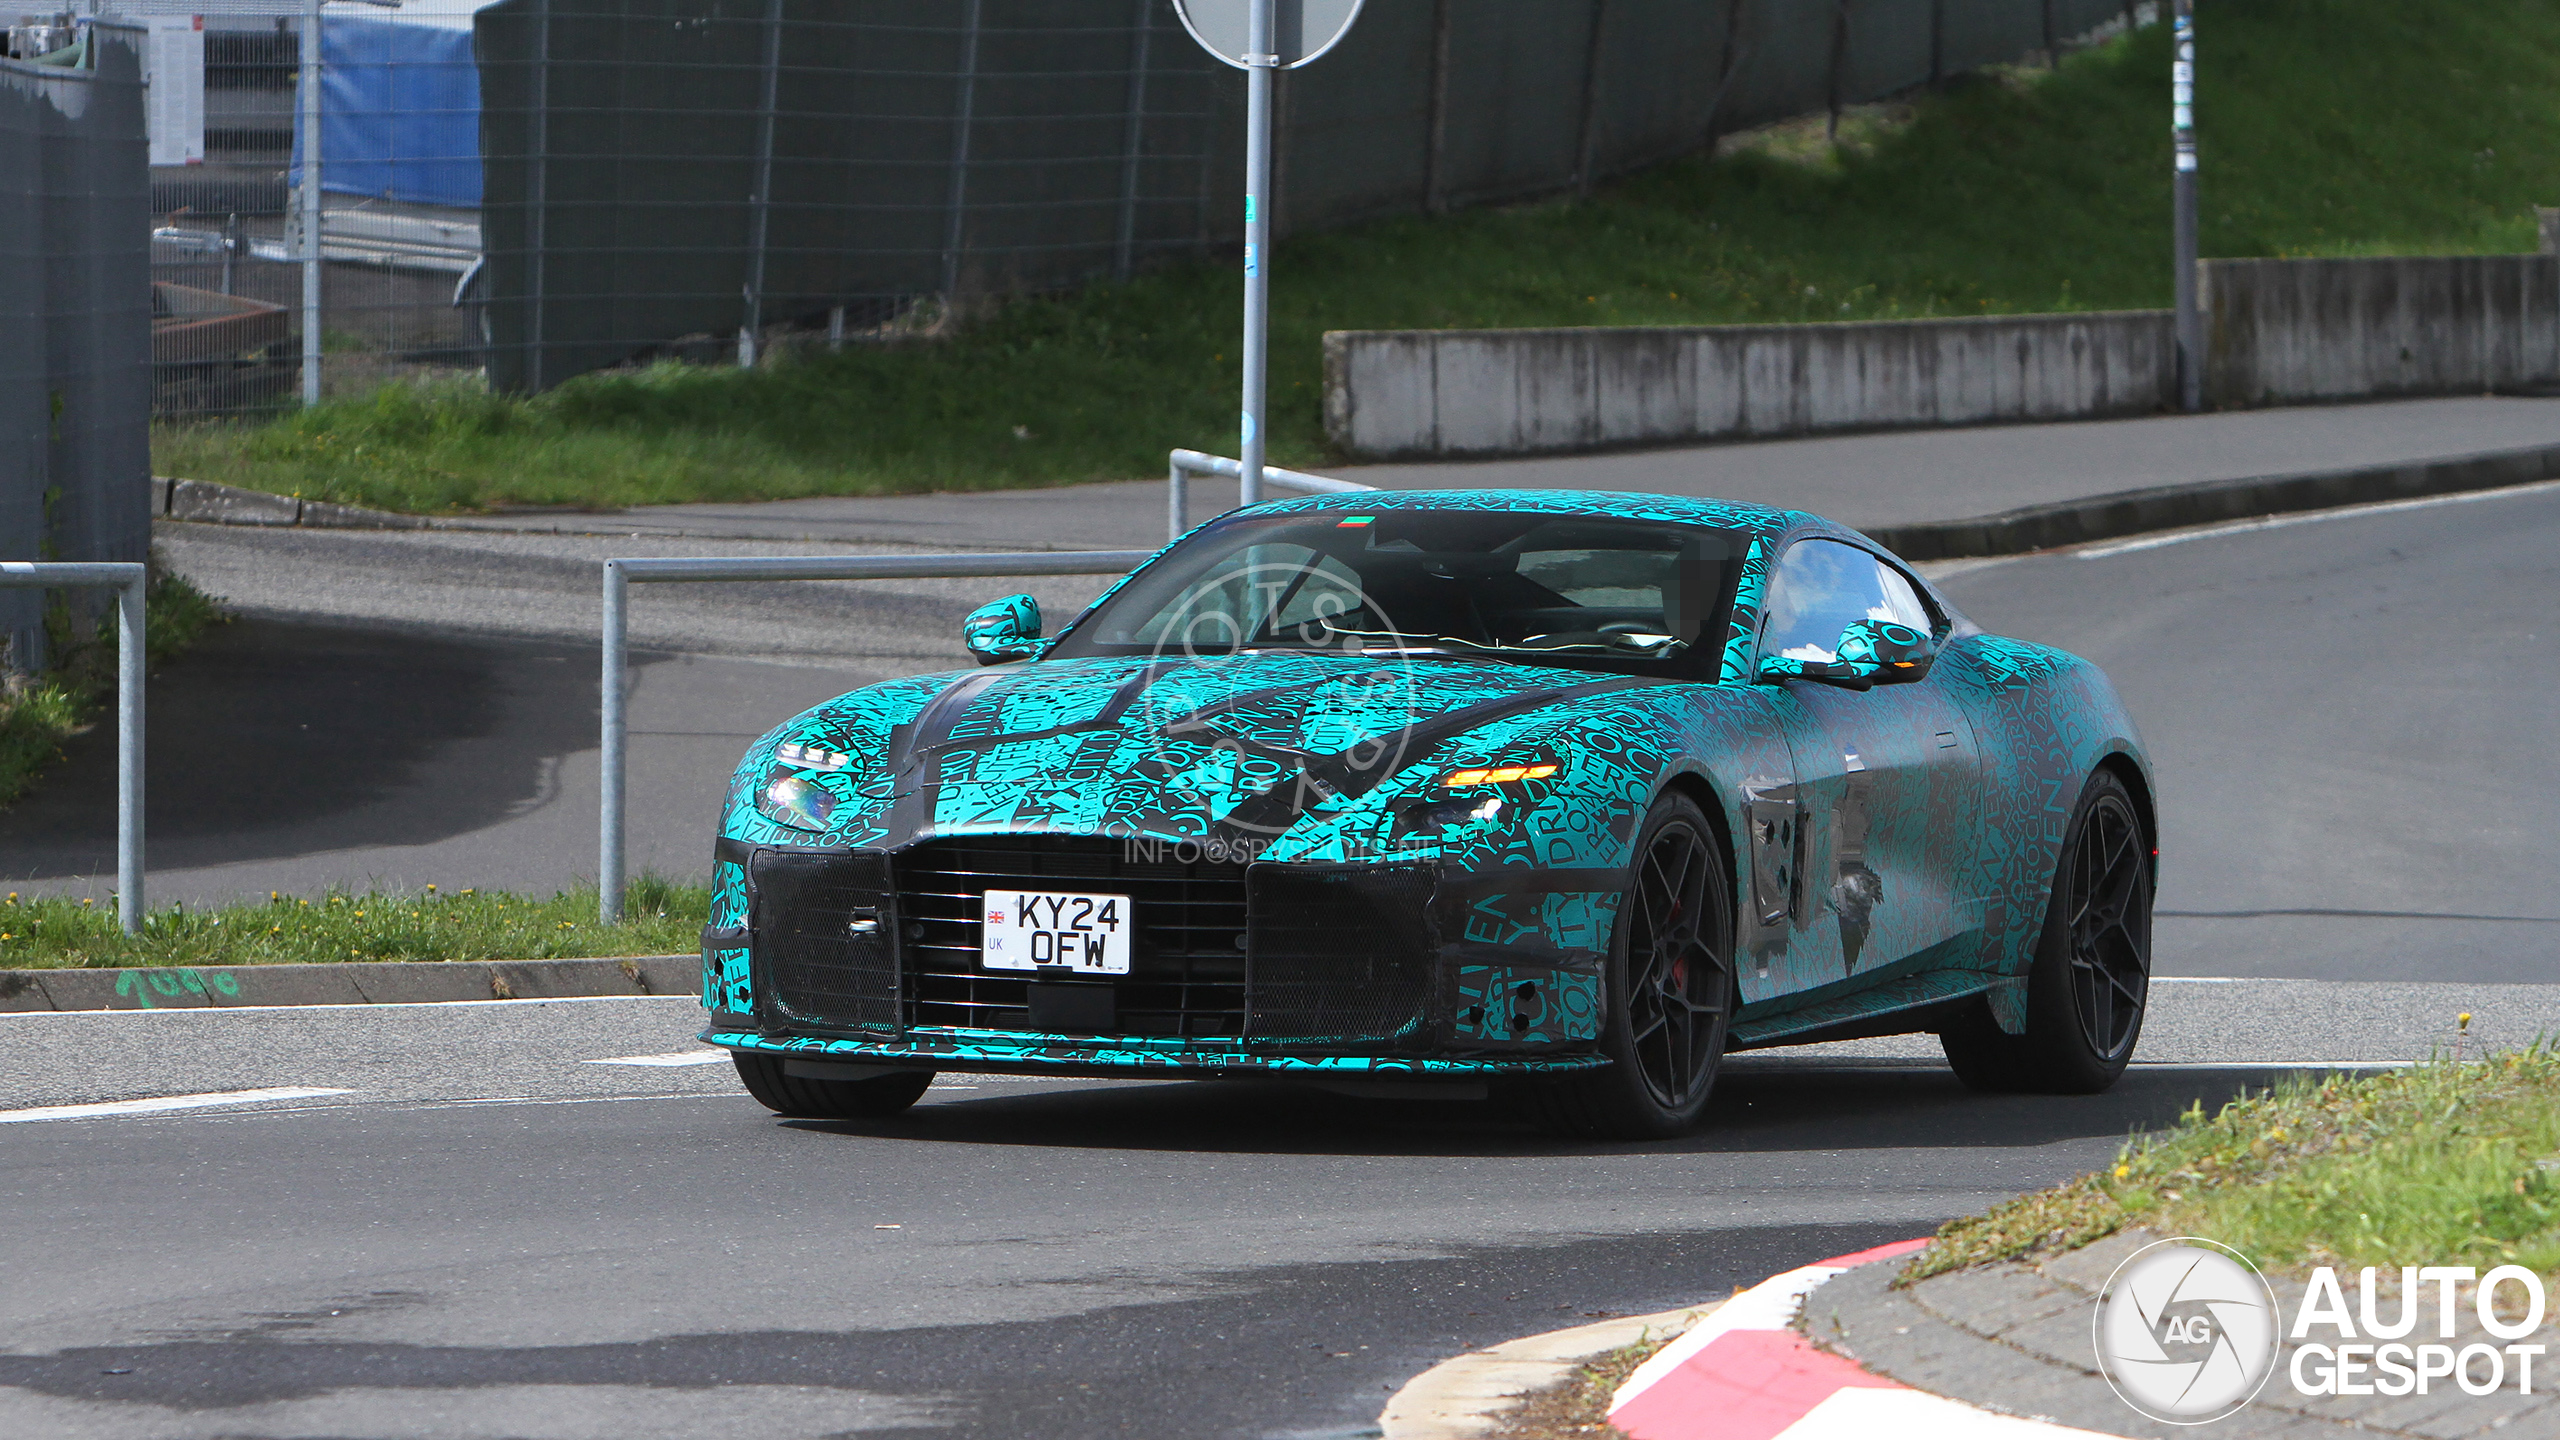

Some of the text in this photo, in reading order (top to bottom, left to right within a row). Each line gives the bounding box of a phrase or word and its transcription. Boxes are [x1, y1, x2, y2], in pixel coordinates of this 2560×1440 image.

[1019, 895, 1119, 932] KY24
[988, 938, 1003, 951] UK
[1031, 931, 1106, 967] OFW
